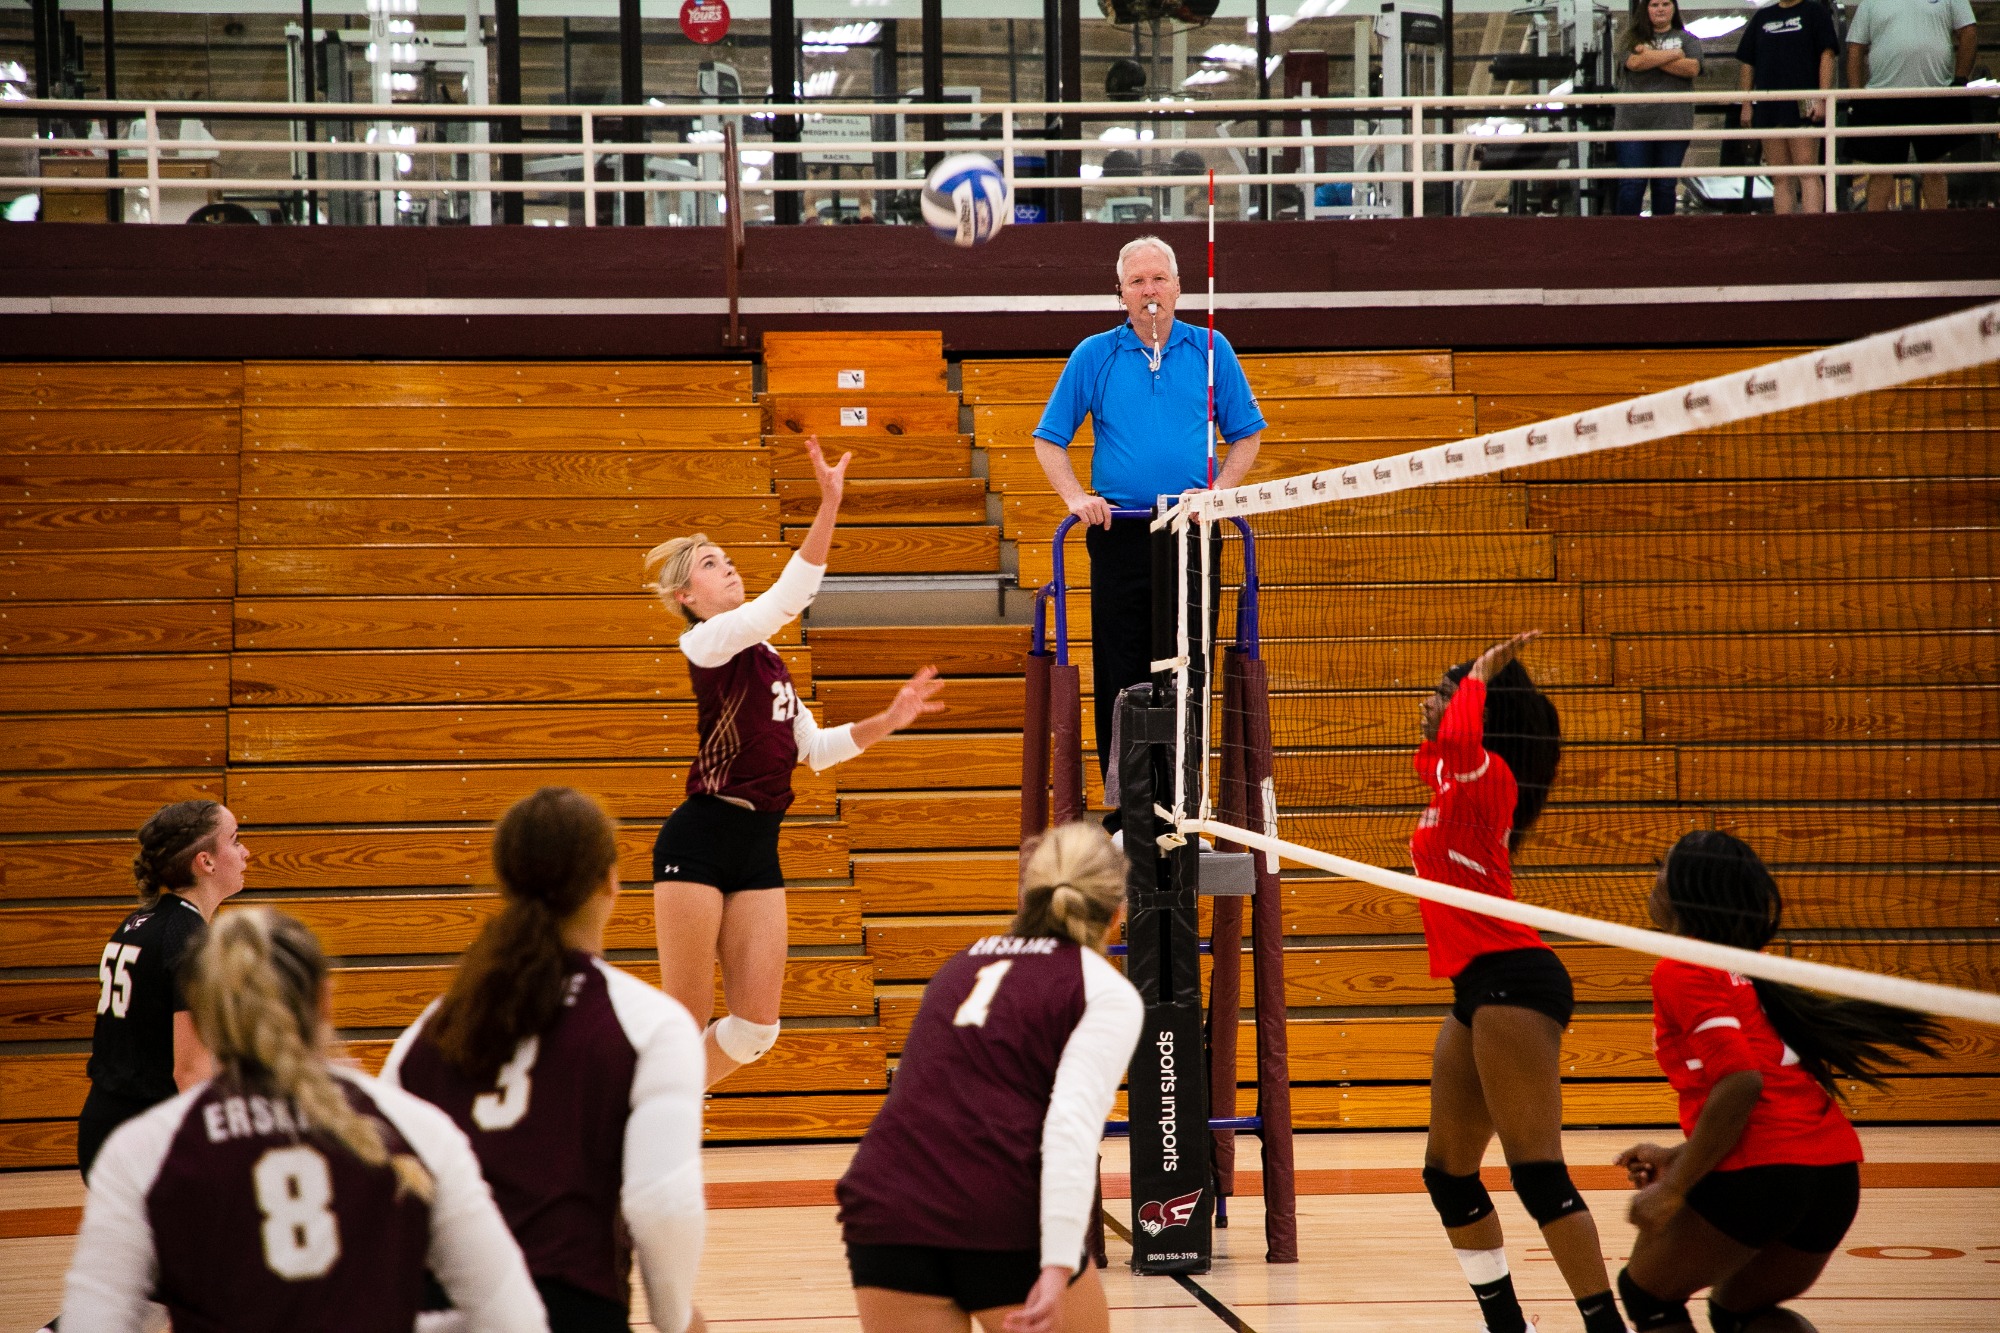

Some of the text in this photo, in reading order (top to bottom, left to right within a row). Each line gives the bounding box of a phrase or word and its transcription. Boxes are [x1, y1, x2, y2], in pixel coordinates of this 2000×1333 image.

[771, 680, 797, 722] 21
[97, 941, 142, 1018] 55
[953, 959, 1013, 1028] 1
[471, 1034, 540, 1132] 3
[1156, 1031, 1179, 1172] sports imports
[253, 1146, 340, 1280] 8
[1166, 1252, 1198, 1260] 556-3198
